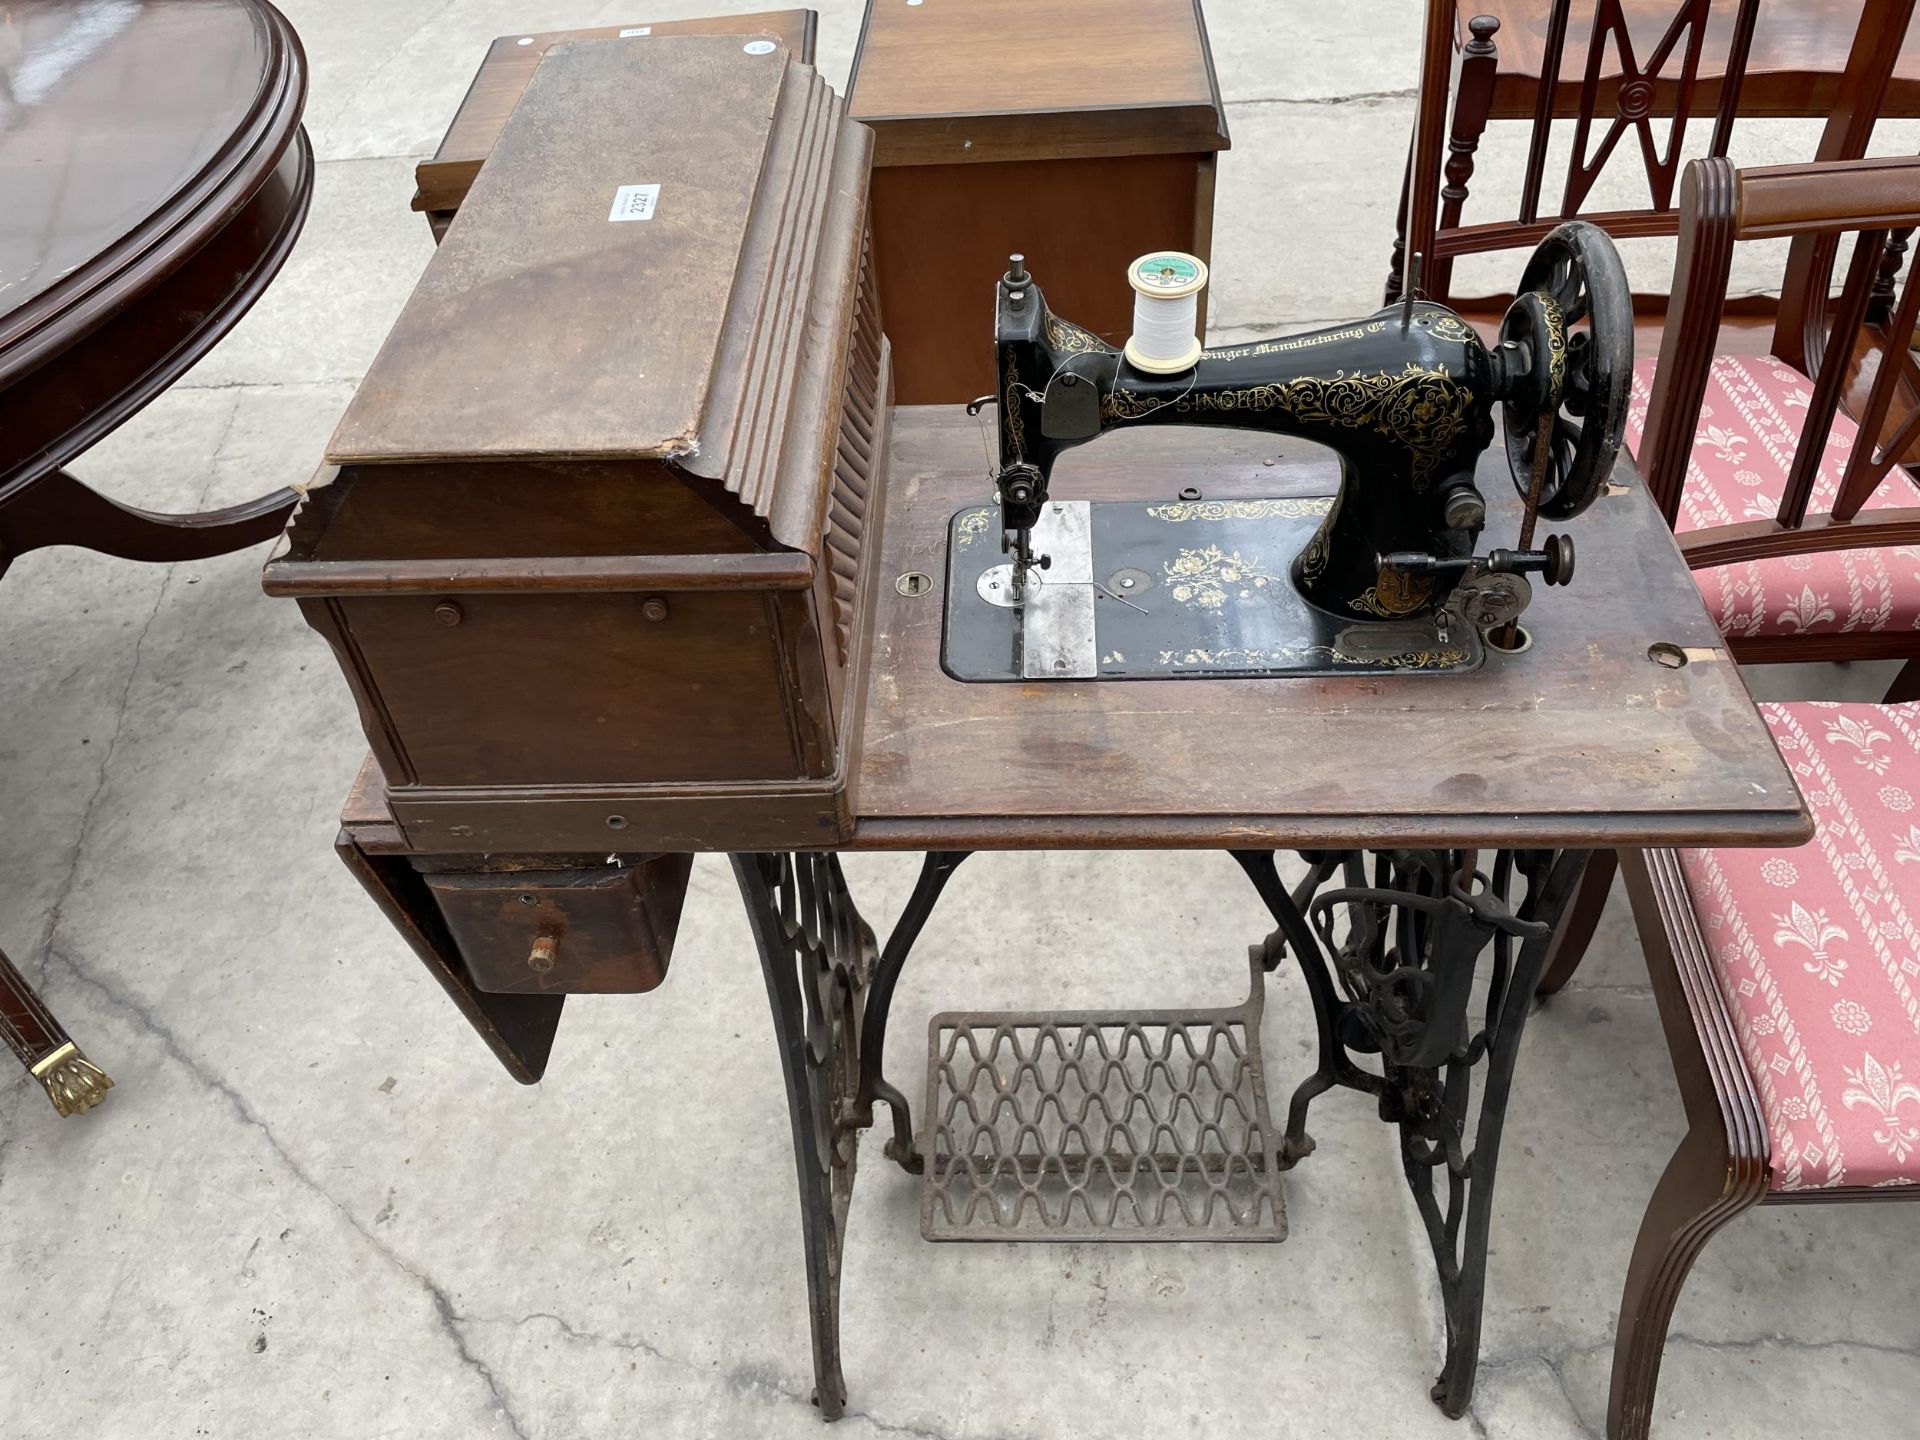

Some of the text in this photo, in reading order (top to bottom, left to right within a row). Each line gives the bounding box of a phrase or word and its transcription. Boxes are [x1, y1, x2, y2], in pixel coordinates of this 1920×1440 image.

[630, 193, 648, 213] 2327
[1145, 273, 1187, 284] DMC
[1199, 348, 1250, 362] Singer
[1253, 327, 1364, 358] Manufacturing
[1176, 389, 1268, 412] SINGER
